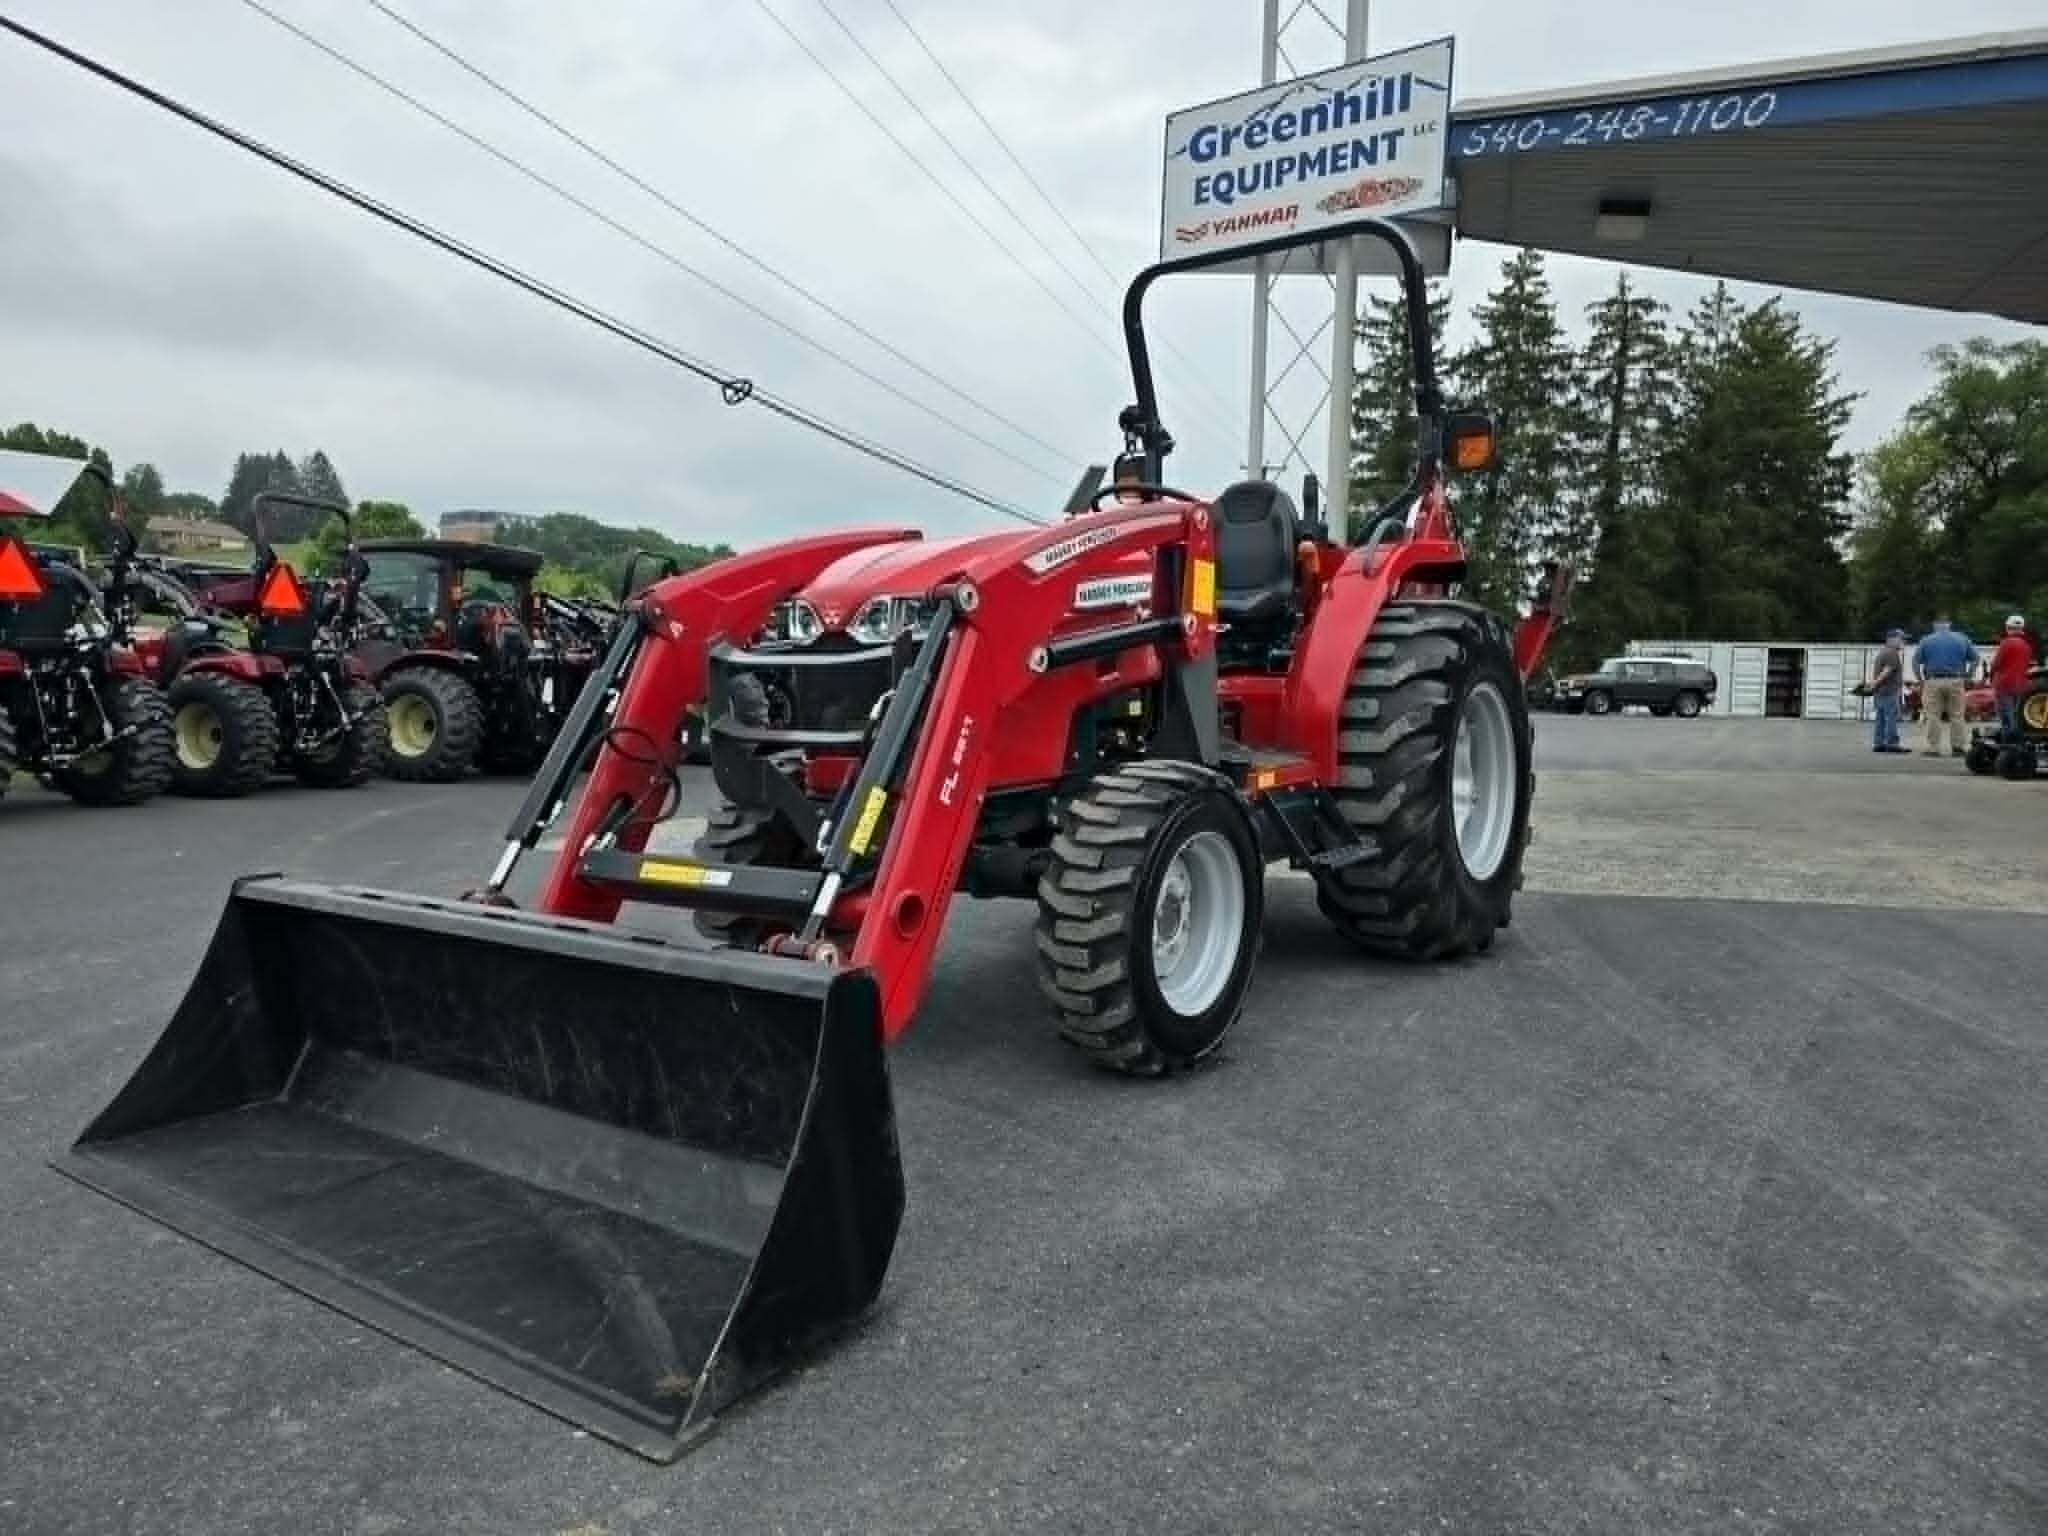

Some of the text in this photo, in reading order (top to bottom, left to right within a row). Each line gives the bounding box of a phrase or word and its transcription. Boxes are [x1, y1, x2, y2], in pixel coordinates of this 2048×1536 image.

[1188, 72, 1412, 162] Greenhill
[1463, 92, 1777, 155] 540-248-1100
[1193, 128, 1405, 205] EQUIPMENT
[1214, 205, 1299, 235] YANMAR
